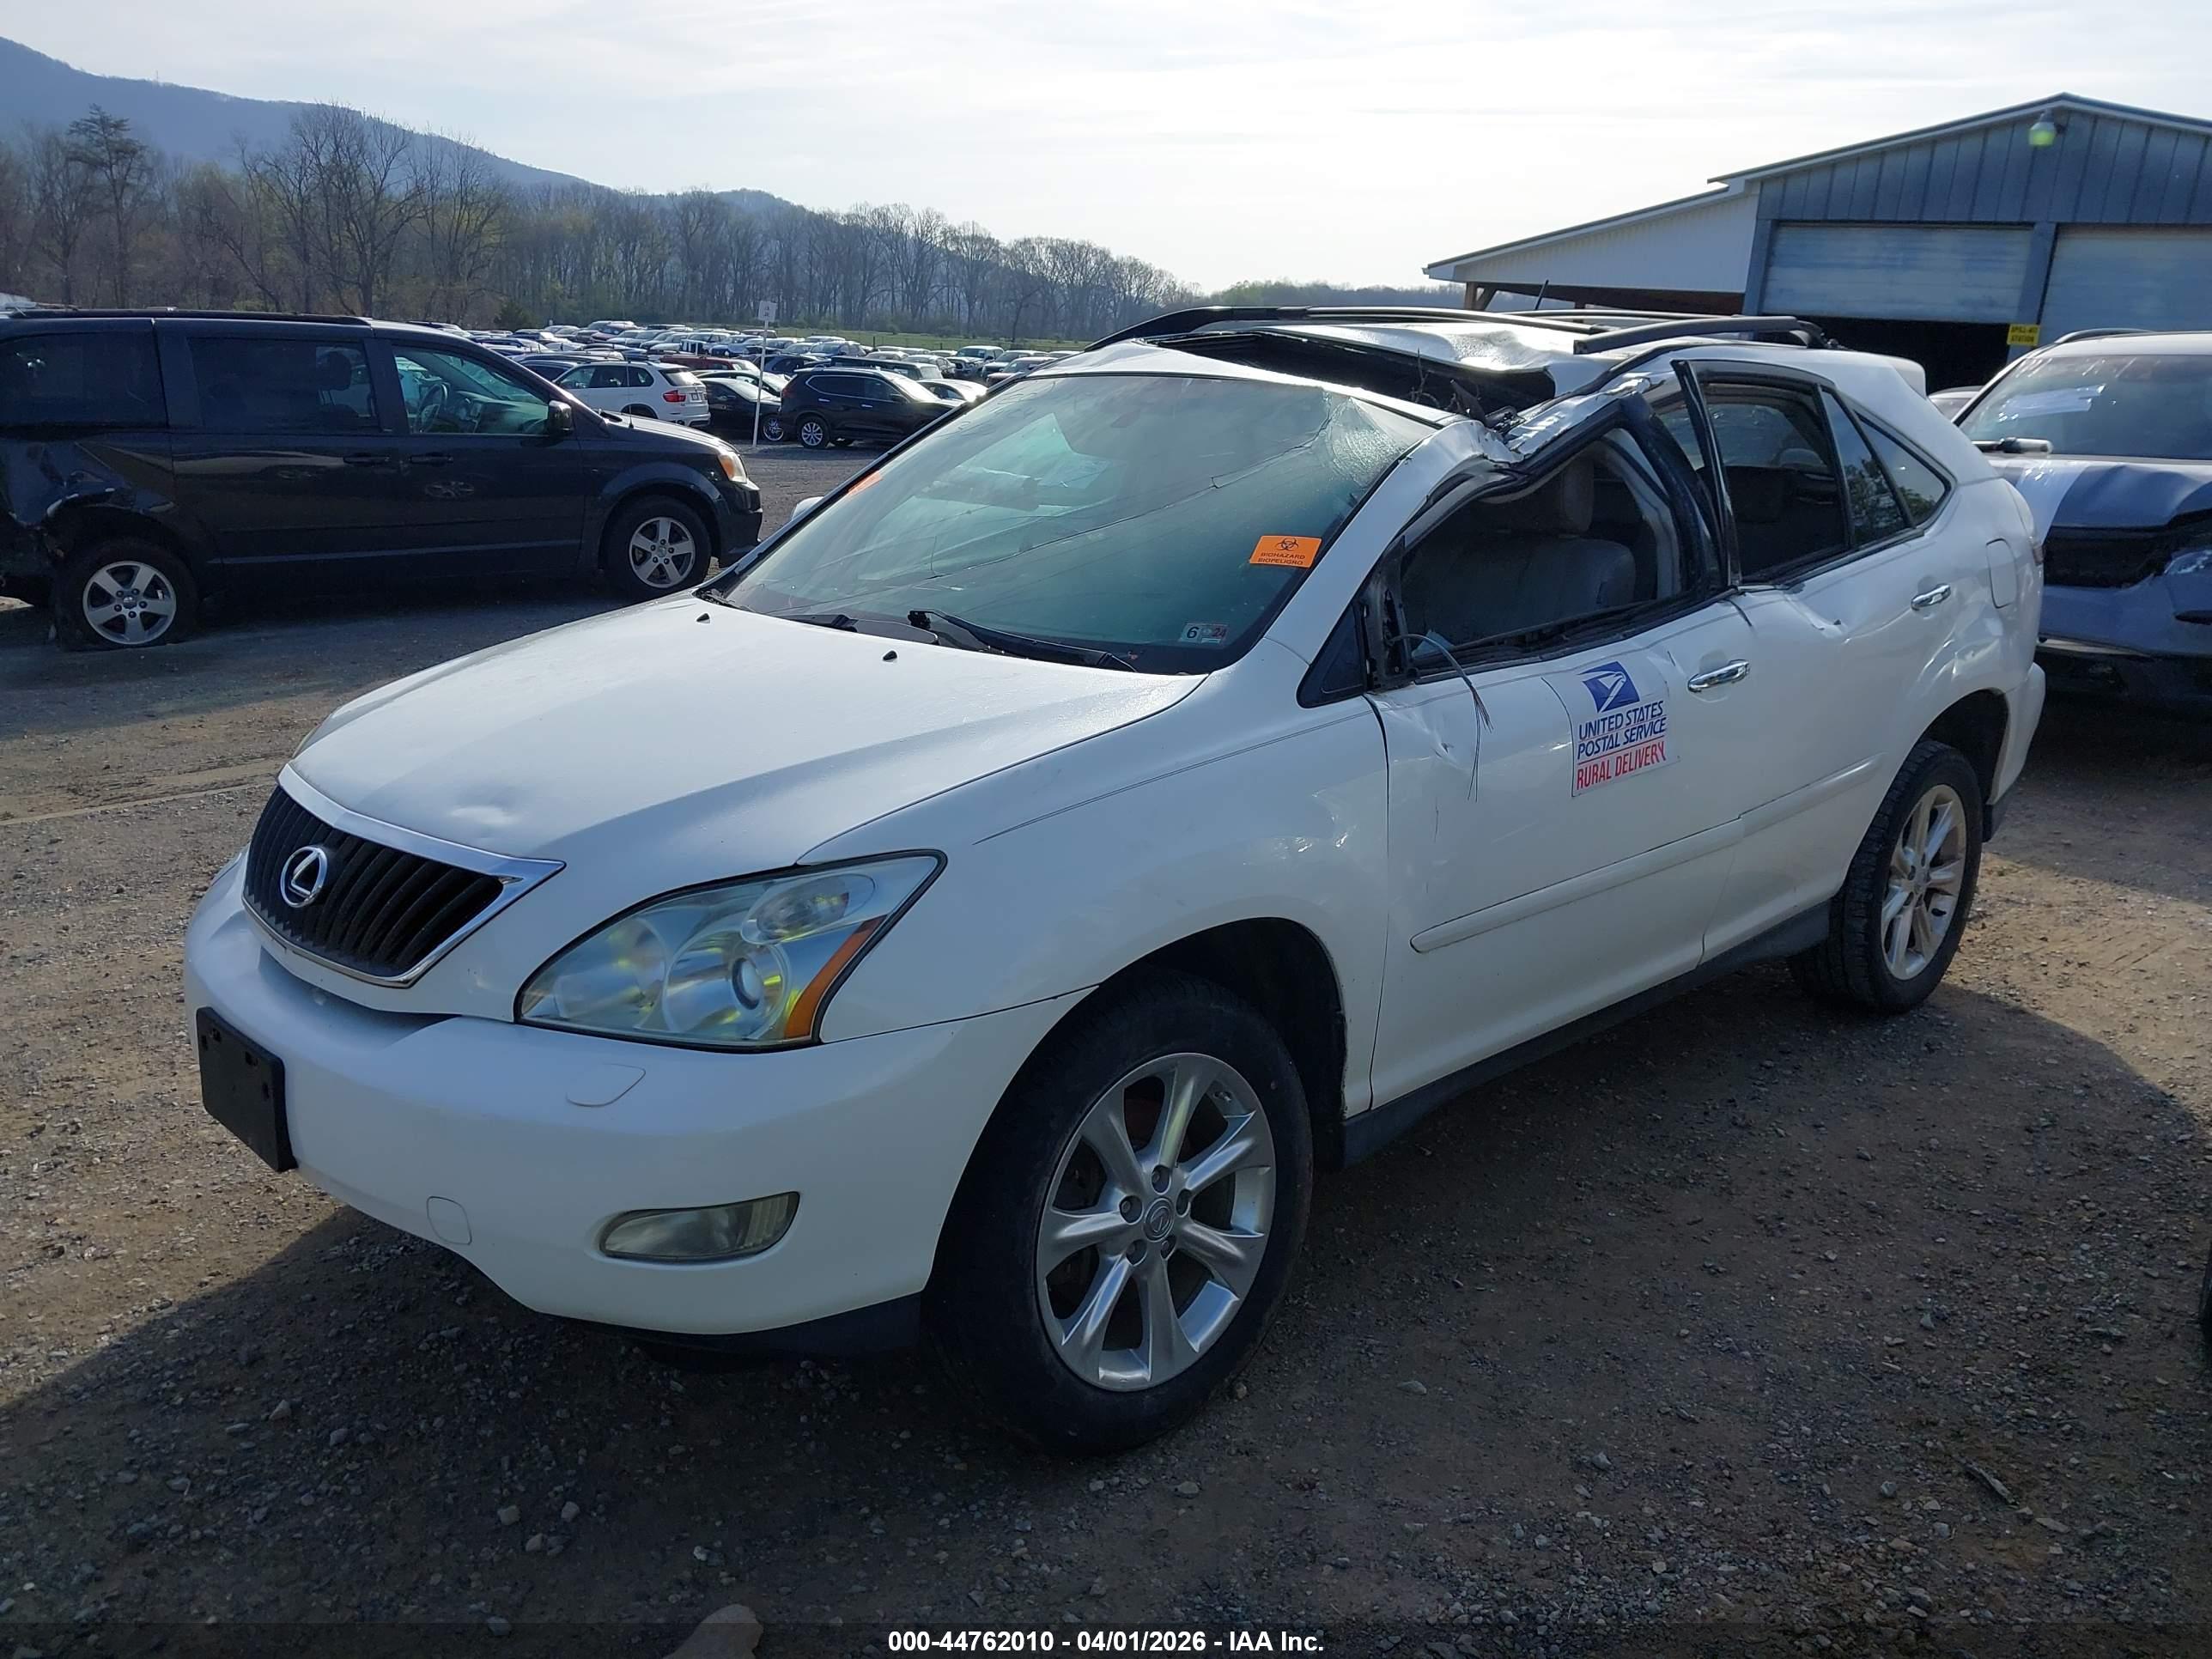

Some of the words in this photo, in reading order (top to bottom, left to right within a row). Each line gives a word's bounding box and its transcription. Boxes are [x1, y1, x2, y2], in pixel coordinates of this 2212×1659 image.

[1261, 551, 1305, 560] BIOHAZARD
[1187, 627, 1200, 638] 6
[1577, 732, 1621, 760] POSTAL
[1623, 716, 1667, 745] SERVICE
[1579, 713, 1624, 740] UNITED
[1626, 700, 1664, 726] STATES
[1577, 760, 1612, 790] RURAL
[1615, 740, 1666, 777] DELIVERY
